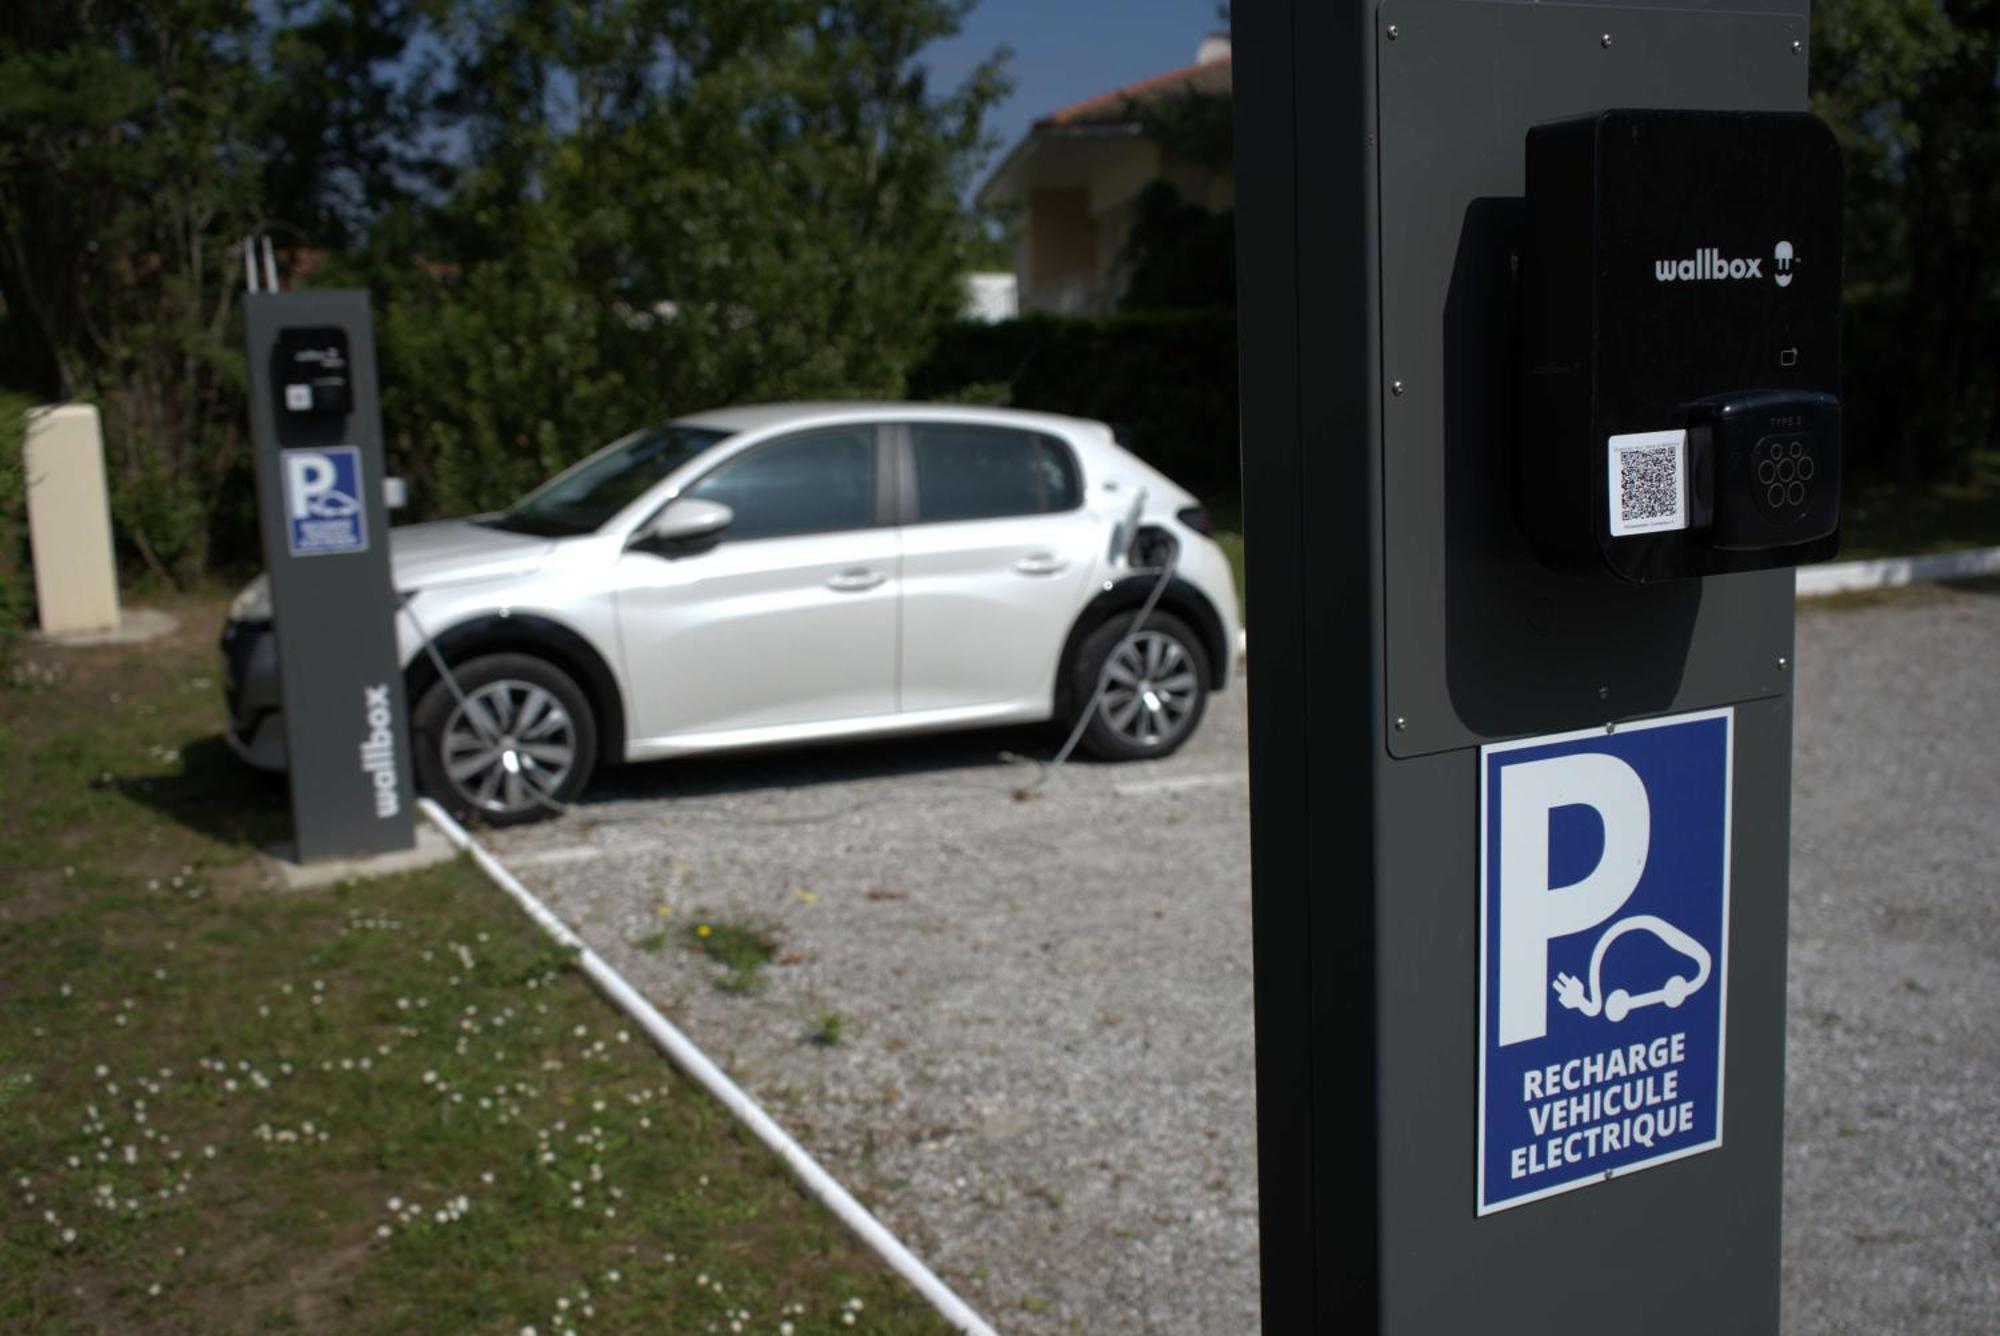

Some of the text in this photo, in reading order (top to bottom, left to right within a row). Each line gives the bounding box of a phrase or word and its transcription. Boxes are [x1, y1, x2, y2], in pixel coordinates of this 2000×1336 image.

[1655, 248, 1763, 281] wallbox
[288, 454, 337, 519] P
[360, 683, 400, 819] wallbox
[1498, 752, 1651, 1047] P
[1523, 1032, 1686, 1102] RECHARGE
[1528, 1070, 1678, 1136] VEHICULE
[1511, 1101, 1694, 1180] ELECTRIQUE
